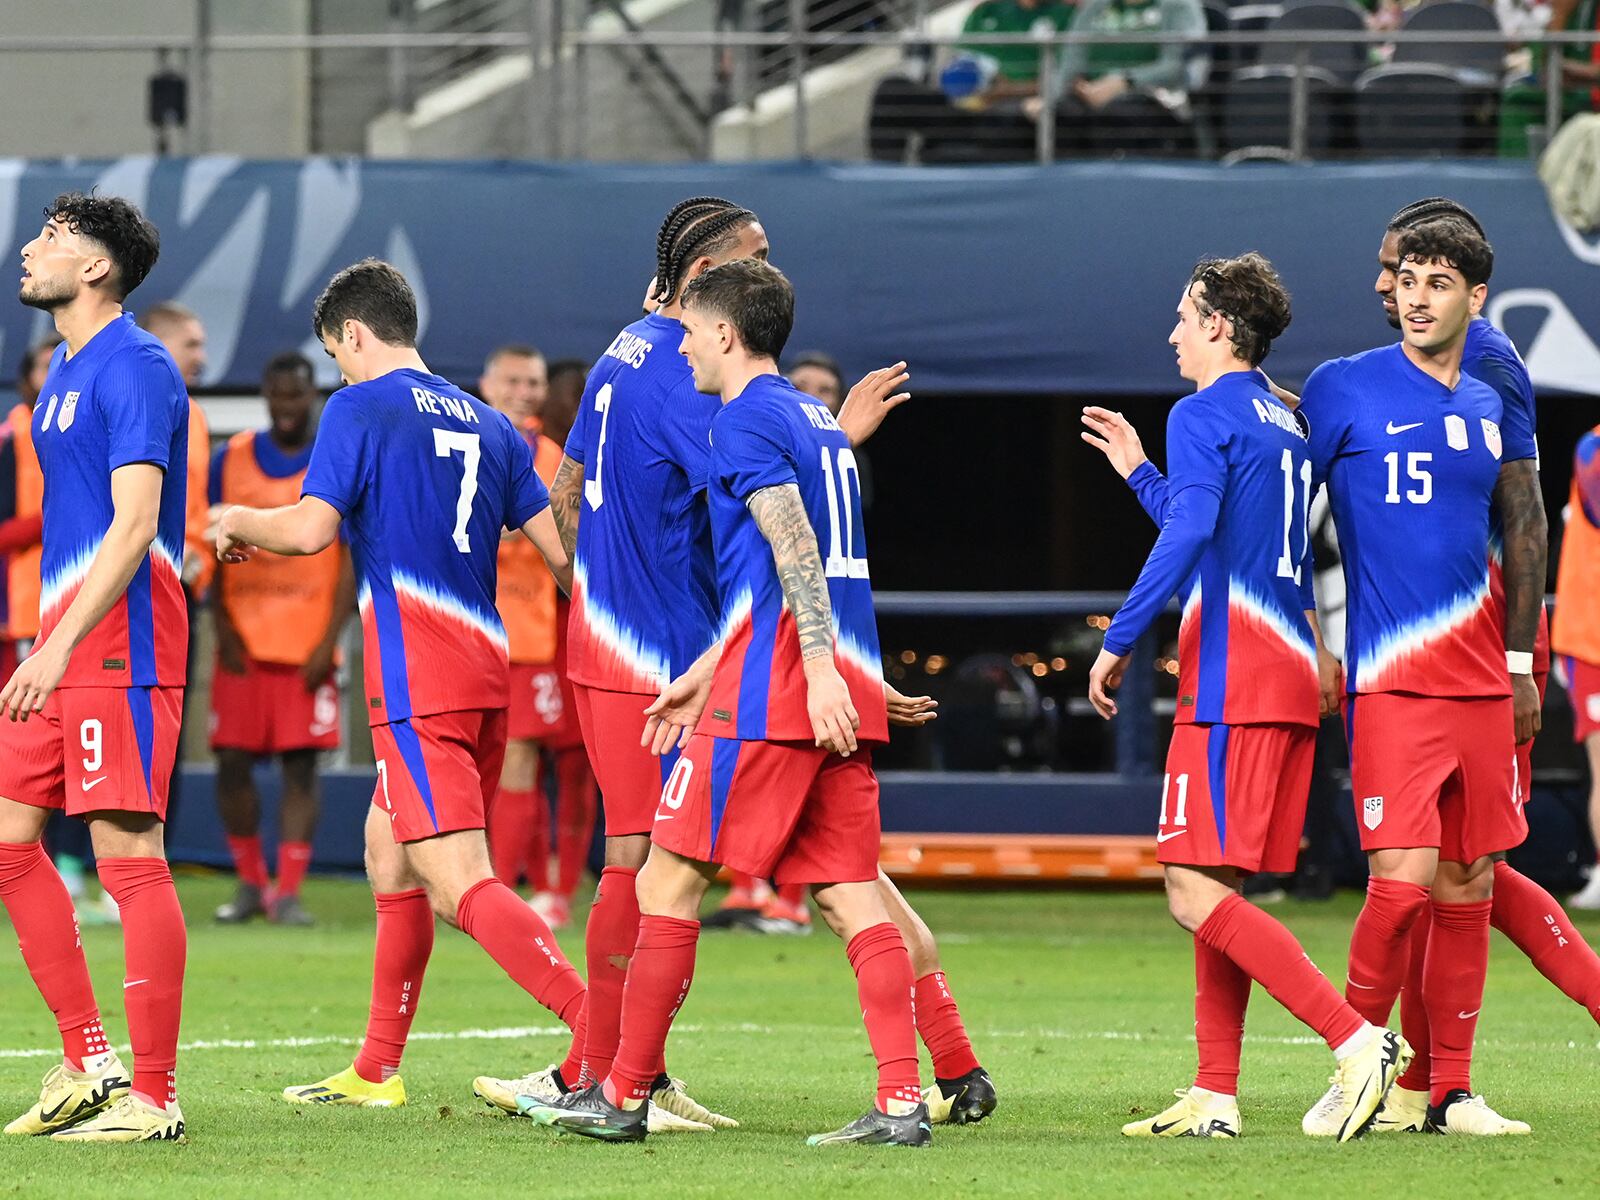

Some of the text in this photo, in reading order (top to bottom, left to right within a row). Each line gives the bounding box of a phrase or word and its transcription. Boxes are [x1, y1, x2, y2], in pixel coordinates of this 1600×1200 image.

[411, 387, 480, 424] REYNA
[432, 428, 481, 553] 7
[1383, 451, 1433, 504] 15
[820, 446, 870, 579] 10
[1276, 448, 1312, 587] 11
[80, 718, 103, 772] 9
[376, 759, 392, 810] 7
[1159, 773, 1189, 826] 11
[534, 936, 559, 967] USA
[1543, 914, 1569, 948] USA
[398, 981, 412, 1014] USA
[934, 973, 950, 998] USA
